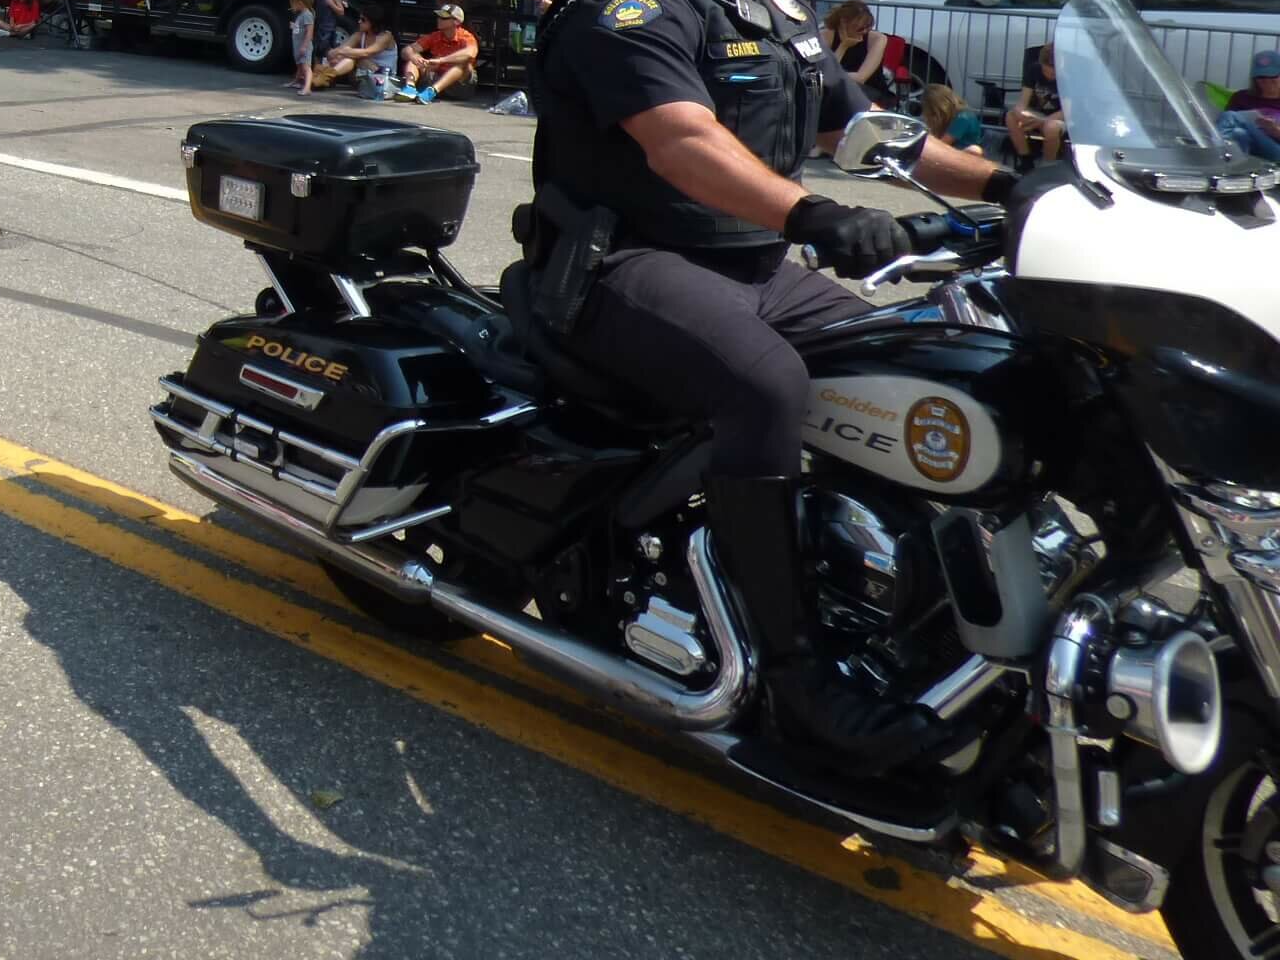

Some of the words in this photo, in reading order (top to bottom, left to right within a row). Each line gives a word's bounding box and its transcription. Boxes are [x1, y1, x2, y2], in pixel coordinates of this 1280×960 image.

[247, 335, 349, 380] POLICE
[819, 388, 898, 422] Golden
[800, 411, 899, 454] LICE
